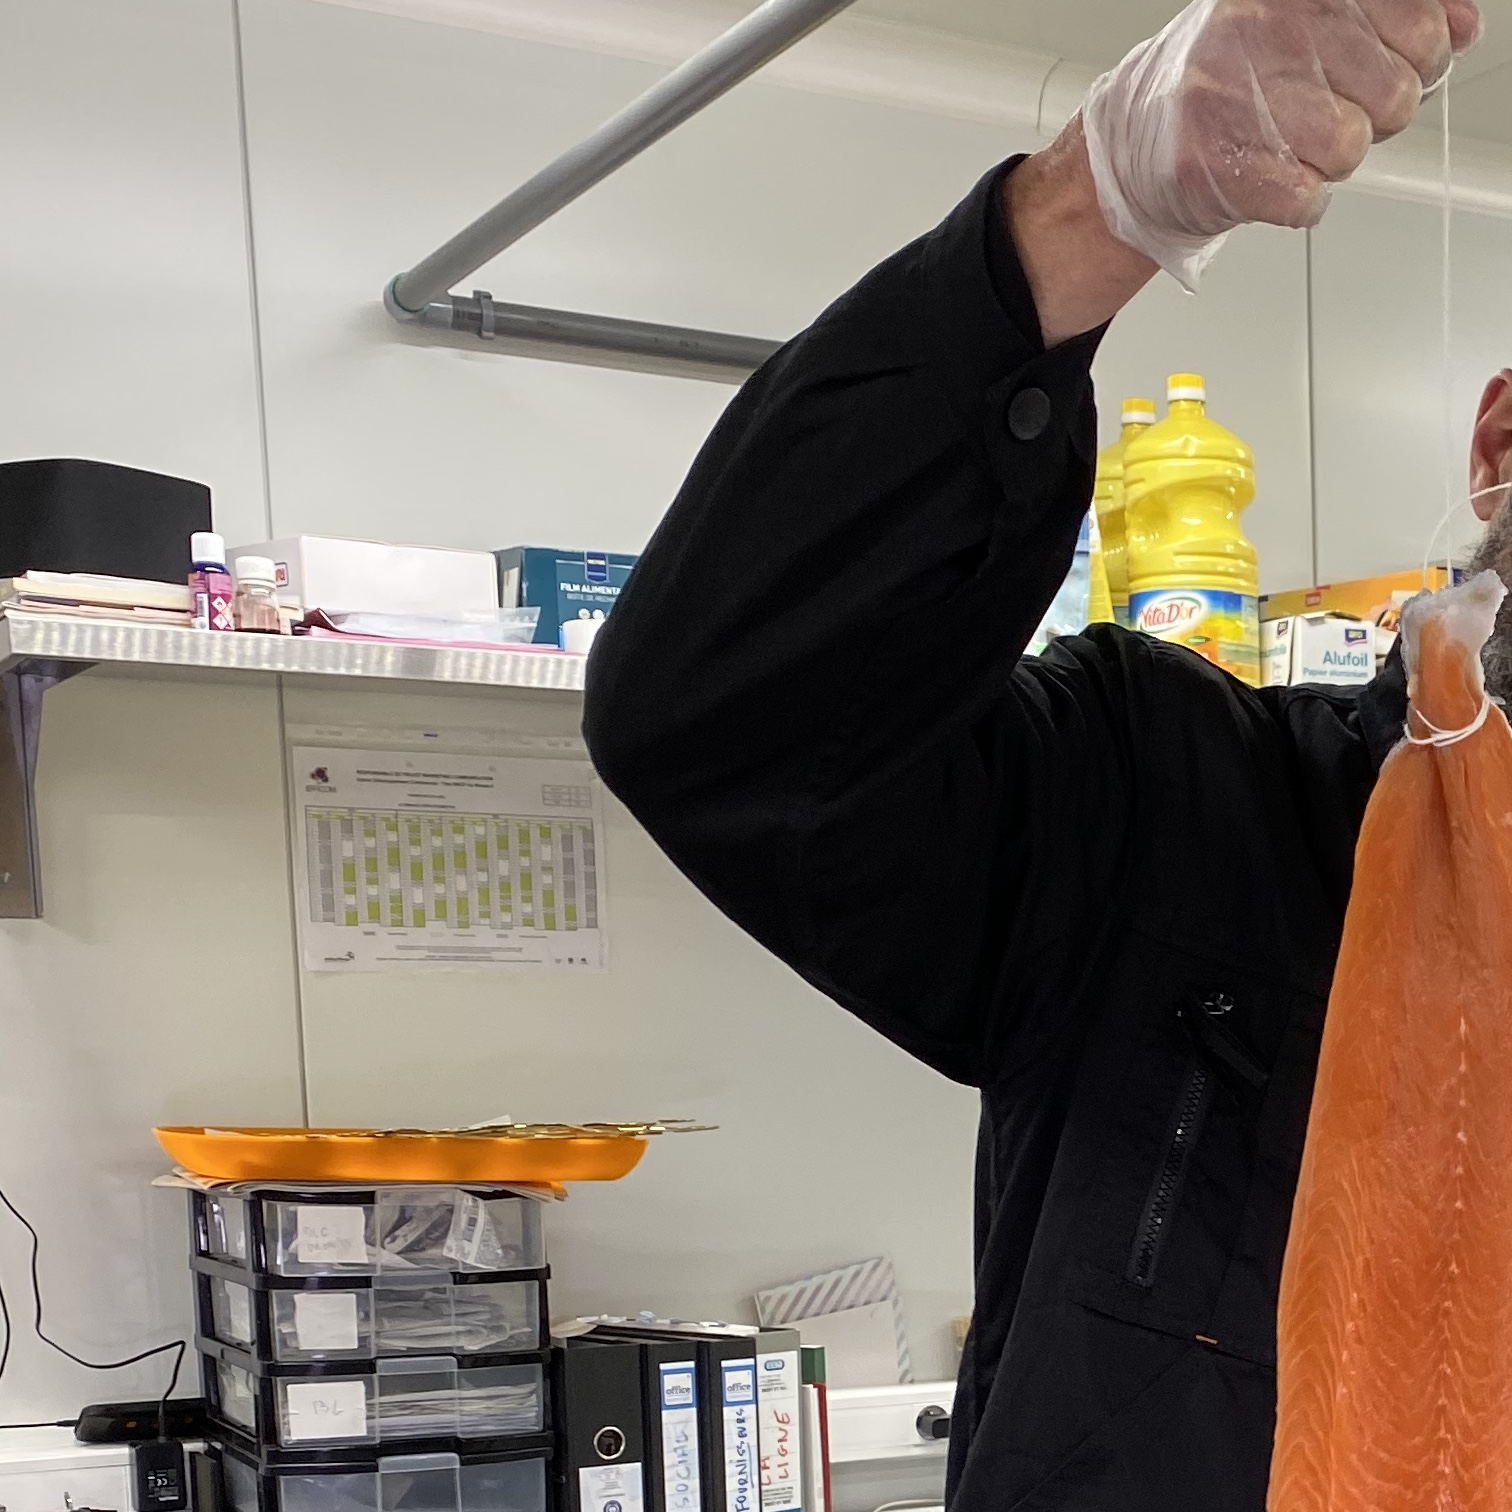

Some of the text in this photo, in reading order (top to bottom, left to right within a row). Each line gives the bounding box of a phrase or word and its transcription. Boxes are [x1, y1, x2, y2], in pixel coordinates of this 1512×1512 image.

[1141, 602, 1165, 628] Vita
[1323, 650, 1368, 667] Alufoil
[666, 1384, 691, 1395] office
[726, 1382, 751, 1392] office
[773, 1410, 791, 1480] LIGNE
